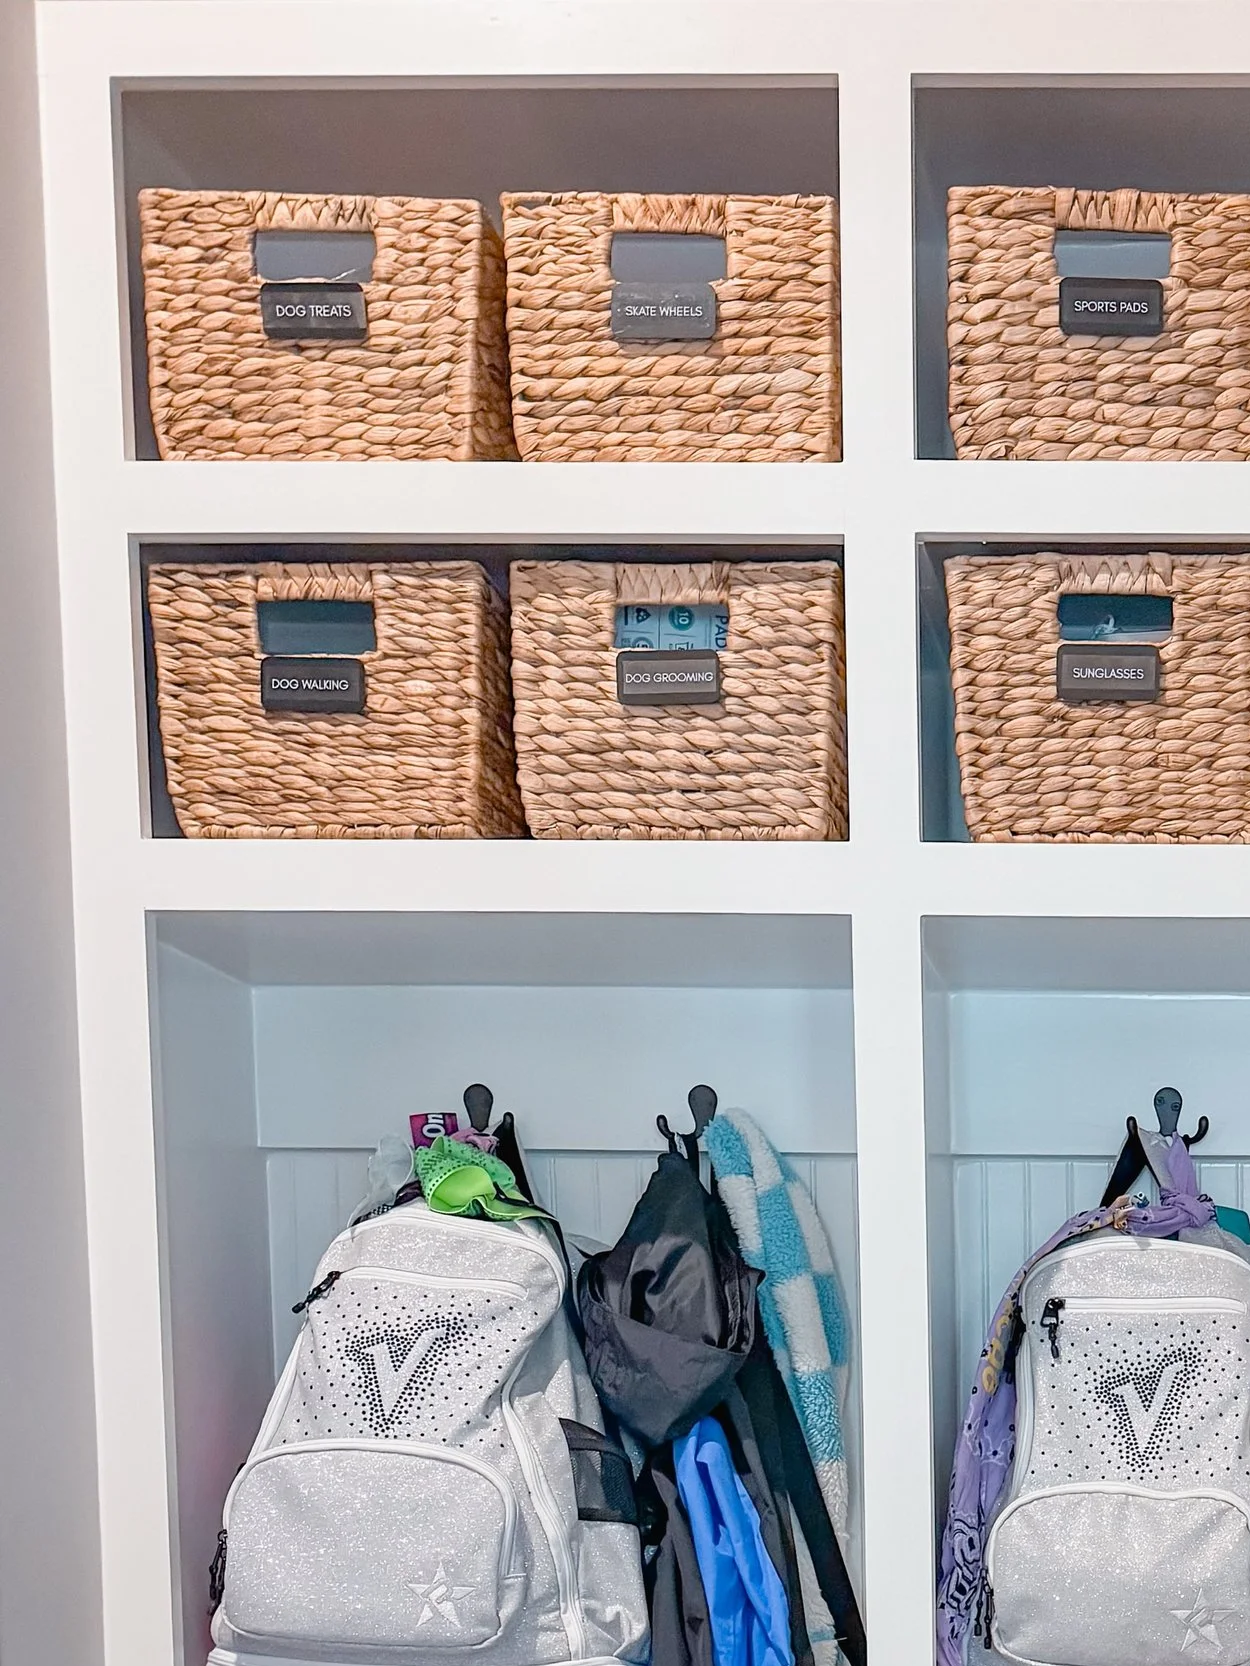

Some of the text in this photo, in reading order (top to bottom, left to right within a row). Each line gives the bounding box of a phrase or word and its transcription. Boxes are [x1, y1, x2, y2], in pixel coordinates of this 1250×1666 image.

[275, 304, 352, 318] DOG TREATS
[625, 306, 703, 318] SKATE WHEELS
[1074, 300, 1149, 314] SPORTS PADS
[625, 671, 714, 684] DOG GROOMING
[1072, 667, 1145, 680] SUNGLASSES
[271, 678, 350, 691] DOG WALKING
[344, 1315, 468, 1436] V
[1094, 1344, 1202, 1468] V
